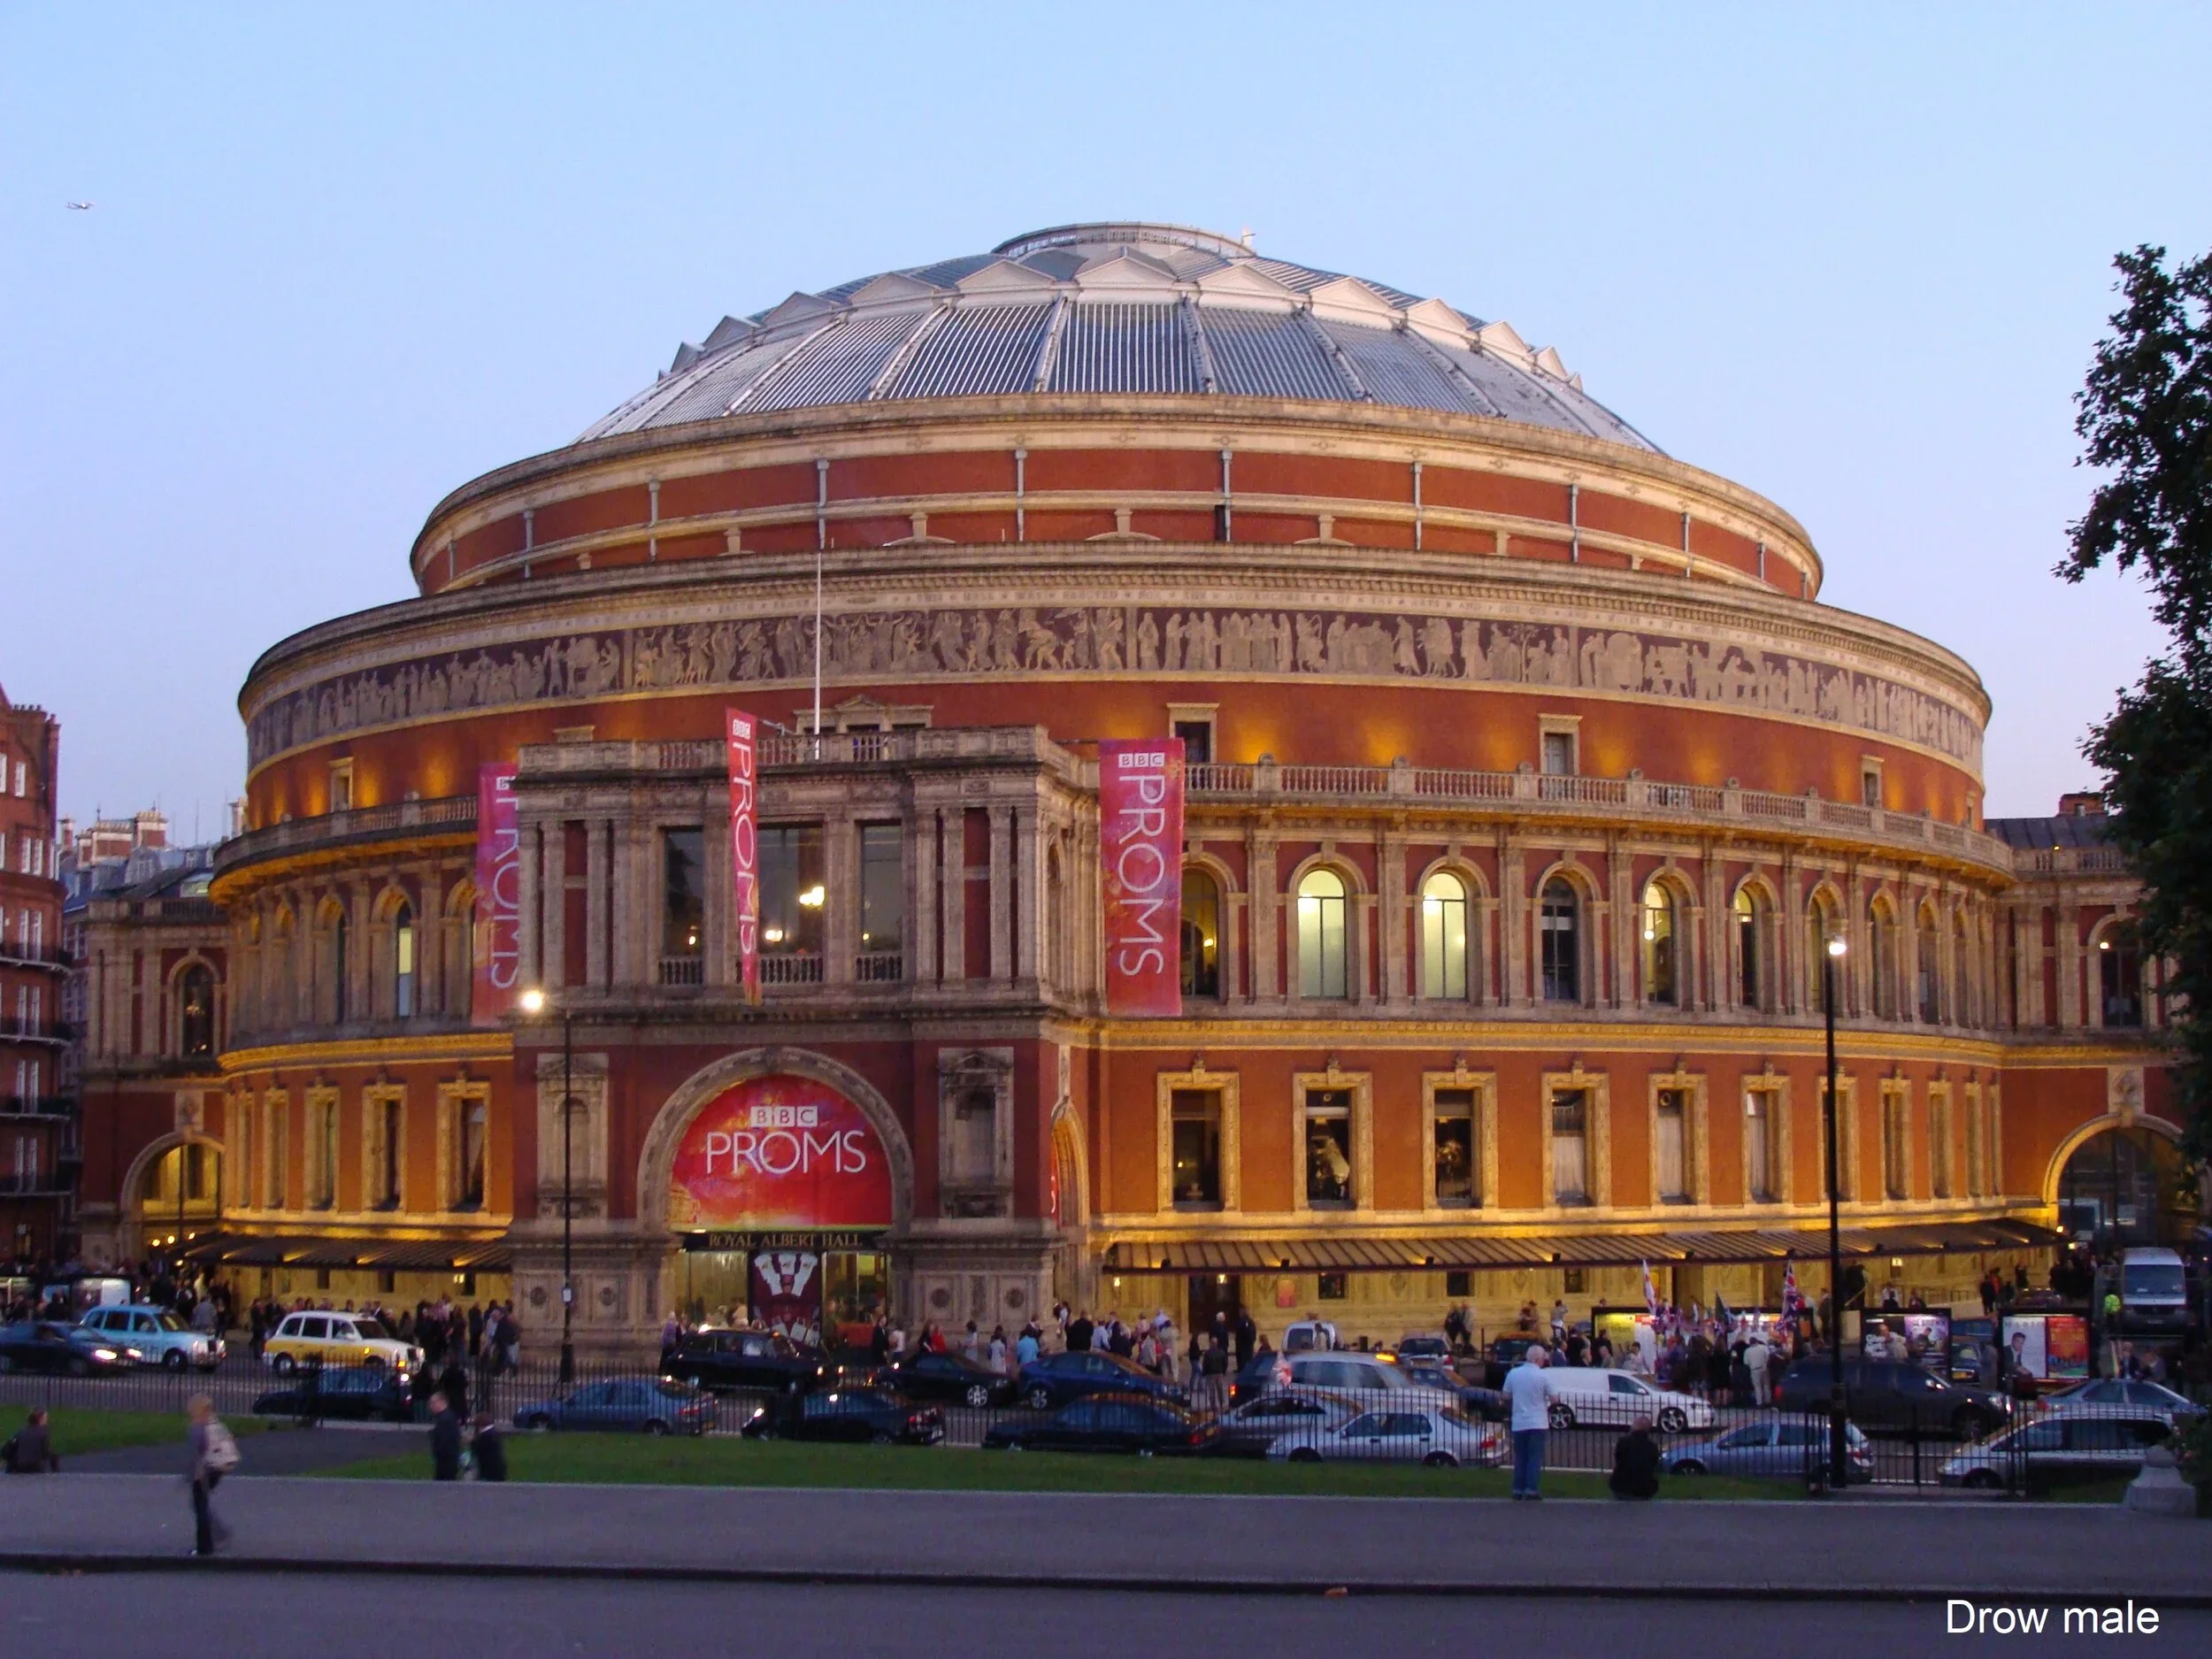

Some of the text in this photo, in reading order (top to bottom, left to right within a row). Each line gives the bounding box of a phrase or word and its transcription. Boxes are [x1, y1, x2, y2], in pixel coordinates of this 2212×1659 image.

[1119, 754, 1164, 766] BBC
[733, 741, 757, 955] PROMS
[1118, 775, 1164, 976] PROMS
[752, 1108, 816, 1125] BBC
[706, 1130, 867, 1175] PROMS
[709, 1233, 864, 1248] ROYAL ALBERT HALL
